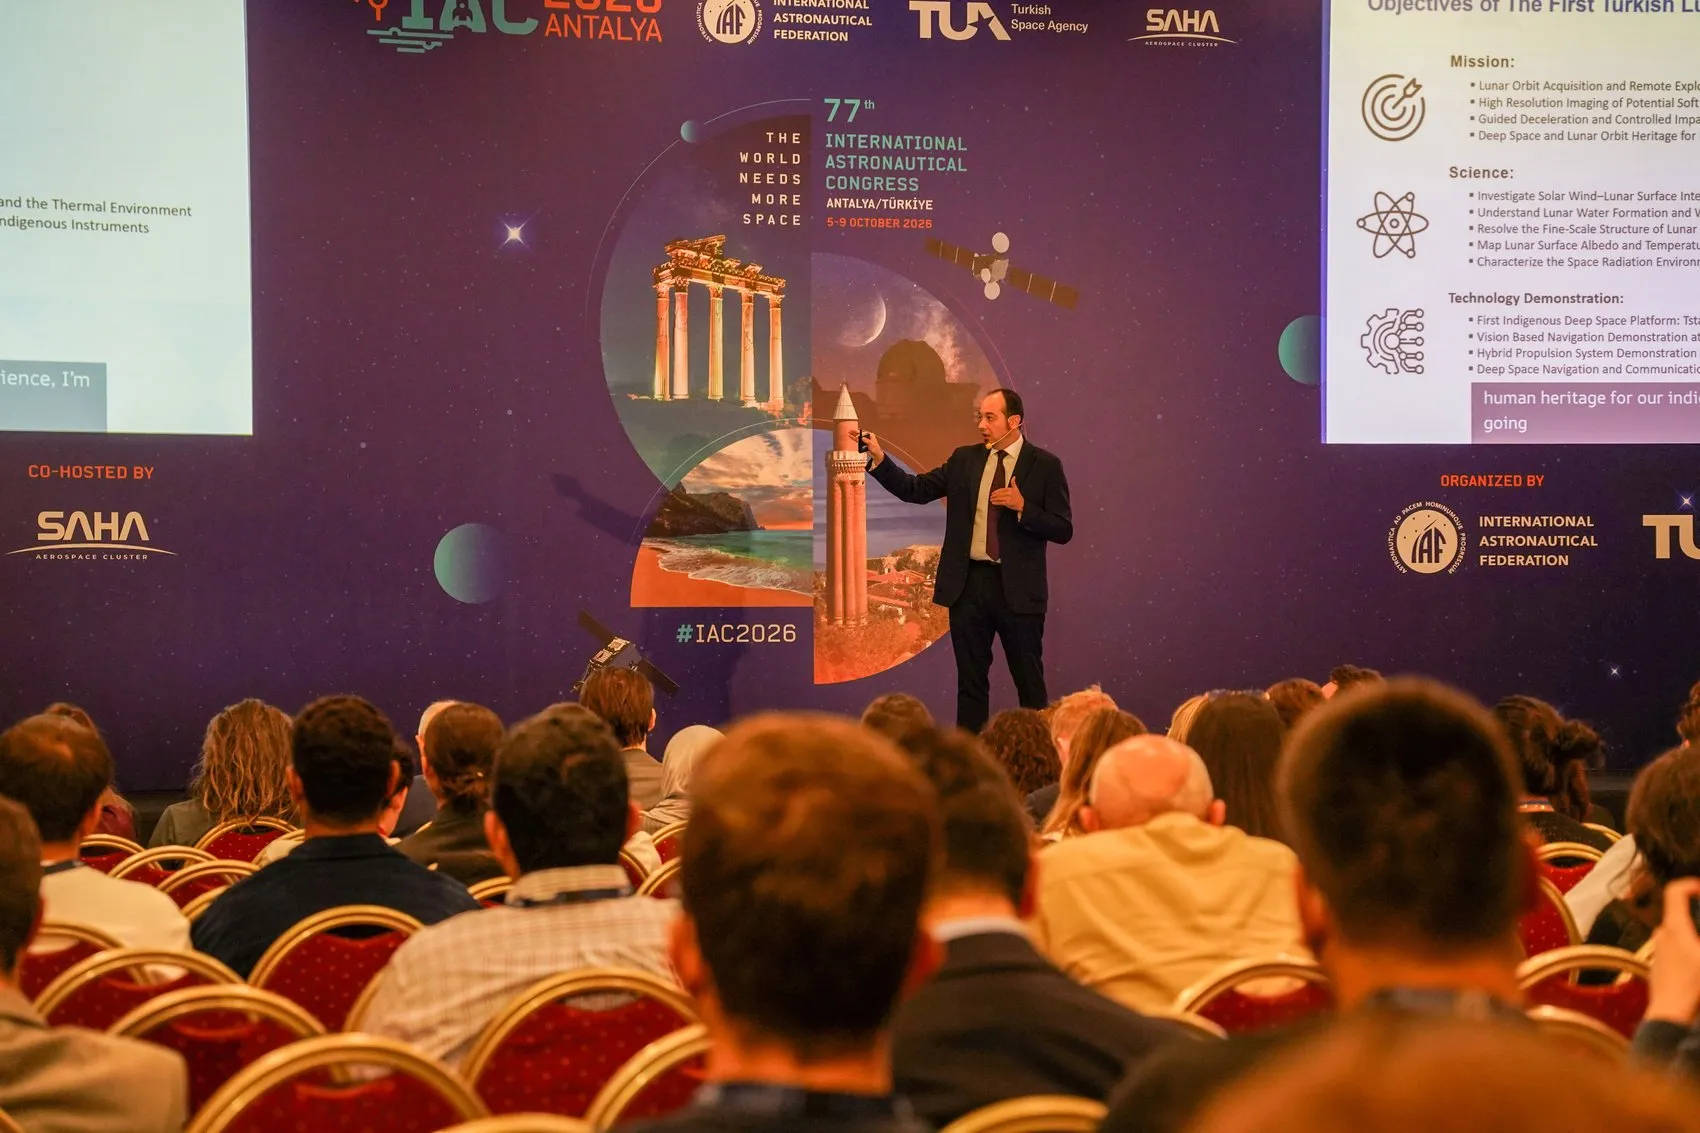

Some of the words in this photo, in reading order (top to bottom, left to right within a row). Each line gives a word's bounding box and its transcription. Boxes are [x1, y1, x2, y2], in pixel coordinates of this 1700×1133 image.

[774, 0, 870, 10] INTERNATIONAL
[1011, 4, 1051, 15] Turkish
[1368, 0, 1473, 15] Objectives
[1480, 0, 1499, 12] of
[1509, 0, 1542, 12] The
[1550, 0, 1594, 12] First
[1604, 0, 1674, 12] Turkish
[774, 13, 872, 26] ASTRONAUTICAL
[909, 0, 1012, 41] TUA
[1146, 9, 1220, 32] SAHA
[544, 13, 662, 42] ANTALYA
[1011, 19, 1045, 32] Space
[1048, 20, 1088, 34] Agency
[774, 30, 848, 42] FEDERATION
[1450, 54, 1515, 68] Mission:
[1478, 81, 1509, 91] Lunar
[1512, 81, 1540, 91] Orbit
[1543, 81, 1603, 93] Acquisition
[1606, 81, 1626, 91] and
[1630, 81, 1672, 91] Remote
[1478, 98, 1502, 110] High
[1506, 98, 1564, 108] Resolution
[1566, 98, 1608, 110] Imaging
[1612, 98, 1624, 108] of
[1626, 98, 1674, 108] Potential
[1677, 98, 1700, 108] Soft
[1478, 114, 1516, 124] Guided
[1520, 114, 1588, 124] Deceleration
[1592, 114, 1612, 124] and
[1615, 114, 1672, 124] Controlled
[1675, 114, 1700, 126] Impa
[766, 132, 800, 144] THE
[826, 134, 968, 151] INTERNATIONAL
[1478, 130, 1506, 143] Deep
[1510, 130, 1540, 143] Space
[1544, 130, 1564, 140] and
[1568, 130, 1598, 140] Lunar
[1600, 130, 1628, 140] Orbit
[1632, 130, 1678, 143] Heritage
[1680, 130, 1696, 140] for
[740, 152, 800, 164] WORLD
[826, 154, 968, 172] ASTRONAUTICAL
[740, 172, 800, 184] NEEDS
[1449, 166, 1514, 179] Science:
[826, 176, 919, 192] CONGRESS
[752, 194, 800, 205] MORE
[1478, 190, 1536, 202] Investigate
[1538, 190, 1566, 200] Solar
[1637, 190, 1677, 200] Surface
[1680, 190, 1700, 200] Inte
[0, 196, 22, 208] and
[26, 196, 48, 210] the
[52, 198, 106, 213] Thermal
[110, 202, 192, 217] Environment
[826, 196, 933, 210] ANTALYA/TÜRKİYE
[1478, 208, 1540, 218] Understand
[1544, 208, 1573, 218] Lunar
[1576, 208, 1609, 218] Water
[1613, 208, 1668, 218] Formation
[1672, 208, 1692, 218] and
[743, 214, 800, 226] SPACE
[826, 217, 846, 227] 5-9
[850, 218, 900, 228] OCTOBER
[904, 218, 932, 228] 2026
[72, 219, 150, 234] Instruments
[1478, 224, 1518, 234] Resolve
[1522, 224, 1539, 234] the
[1542, 224, 1596, 234] Fine-Scale
[1600, 224, 1650, 234] Structure
[1652, 224, 1664, 234] of
[1667, 224, 1698, 234] Lunar
[1478, 240, 1502, 252] Map
[1504, 240, 1535, 250] Lunar
[1538, 240, 1578, 250] Surface
[1581, 240, 1619, 250] Albedo
[1622, 240, 1642, 250] and
[1477, 256, 1544, 267] Characterize
[1547, 256, 1565, 267] the
[1568, 256, 1599, 268] Space
[1602, 256, 1652, 267] Radiation
[1448, 292, 1520, 306] Technology
[1524, 292, 1624, 304] Demonstration:
[1477, 315, 1500, 326] First
[1503, 315, 1562, 327] Indigenous
[1564, 315, 1592, 327] Deep
[1596, 315, 1626, 327] Space
[1630, 315, 1680, 326] Platform:
[1477, 332, 1509, 342] Vision
[1513, 332, 1544, 342] Based
[1548, 332, 1604, 344] Navigation
[1608, 332, 1688, 342] Demonstration
[1477, 348, 1512, 360] Hybrid
[1516, 348, 1572, 360] Propulsion
[1576, 348, 1614, 360] System
[1617, 348, 1696, 358] Demonstration
[1477, 364, 1505, 376] Deep
[1508, 364, 1540, 376] Space
[1542, 364, 1599, 376] Navigation
[1602, 364, 1622, 374] and
[1484, 390, 1536, 404] human
[1541, 390, 1606, 408] heritage
[1610, 390, 1631, 404] for
[1638, 394, 1664, 404] our
[1668, 390, 1700, 404] indi
[1484, 416, 1528, 433] going
[28, 464, 128, 479] CO-HOSTED
[134, 466, 154, 480] BY
[1440, 474, 1522, 487] ORGANIZED
[1527, 475, 1544, 487] BY
[1402, 502, 1422, 514] PACEM
[1394, 515, 1402, 525] AD
[1426, 502, 1464, 530] HOMINUMQUE
[1480, 516, 1594, 528] INTERNATIONAL
[38, 510, 150, 541] SAHA
[1411, 527, 1446, 563] IAF
[1480, 535, 1598, 547] ASTRONAUTICAL
[1388, 528, 1408, 574] ASTRONAUTICA
[1448, 533, 1466, 574] PROGRESSUM
[1480, 554, 1569, 566] FEDERATION
[676, 624, 797, 643] #IAC2026
